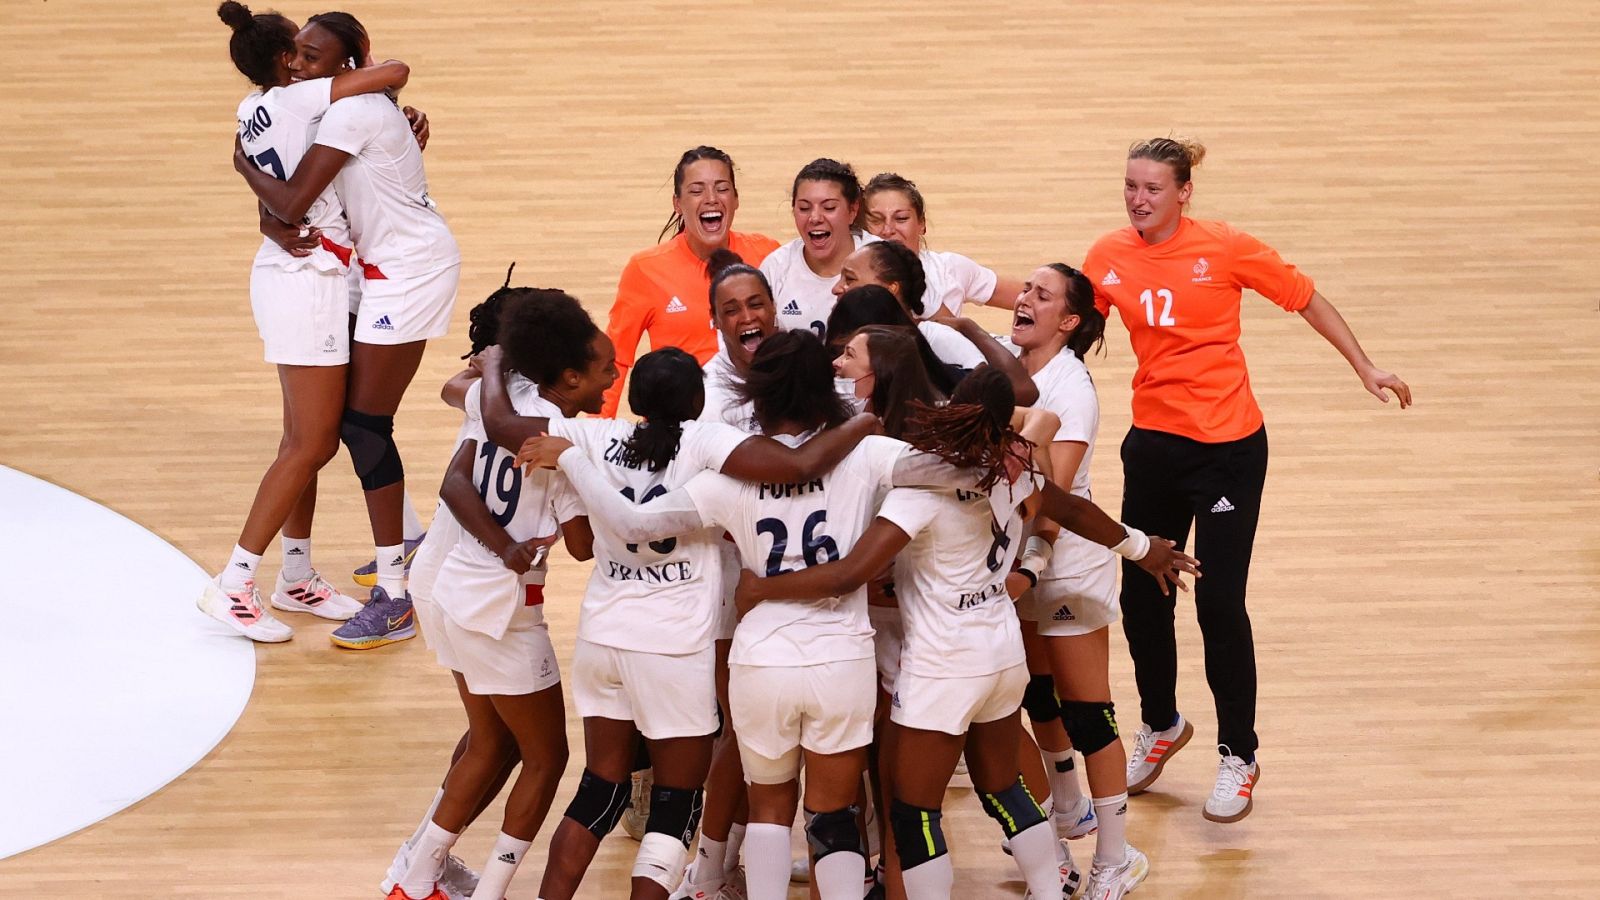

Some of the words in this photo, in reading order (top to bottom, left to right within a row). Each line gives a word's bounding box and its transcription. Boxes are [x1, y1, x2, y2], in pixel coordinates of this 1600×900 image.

[1140, 288, 1176, 327] 12
[480, 440, 523, 528] 19
[756, 509, 840, 577] 26
[608, 560, 692, 584] FRANCE
